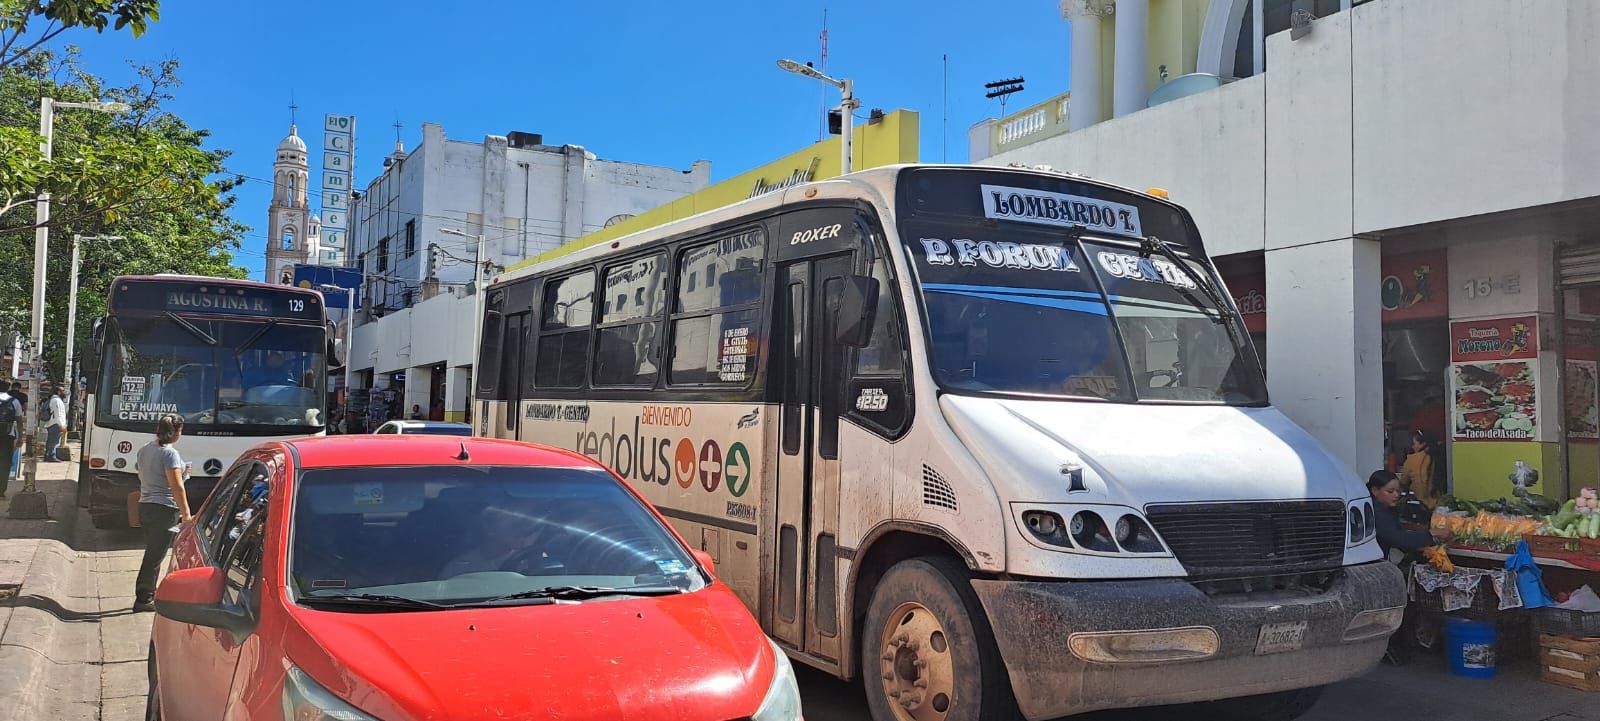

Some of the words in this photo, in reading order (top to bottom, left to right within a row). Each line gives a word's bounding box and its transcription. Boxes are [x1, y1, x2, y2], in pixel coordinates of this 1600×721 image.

[991, 191, 1117, 229] LOMBARDO
[1119, 209, 1135, 232] T.
[790, 223, 842, 246] BOXER
[920, 237, 954, 266] P.
[952, 239, 1080, 273] FORUM
[167, 291, 252, 311] AGUSTINA
[253, 298, 268, 312] R.
[288, 299, 304, 312] 129
[119, 402, 137, 411] LEY
[140, 402, 178, 413] HUMAYA
[119, 411, 165, 421] CENT
[641, 406, 692, 427] BIENVENIDO
[1465, 429, 1486, 439] Taco
[119, 442, 131, 453] 129
[1059, 464, 1091, 495] 1
